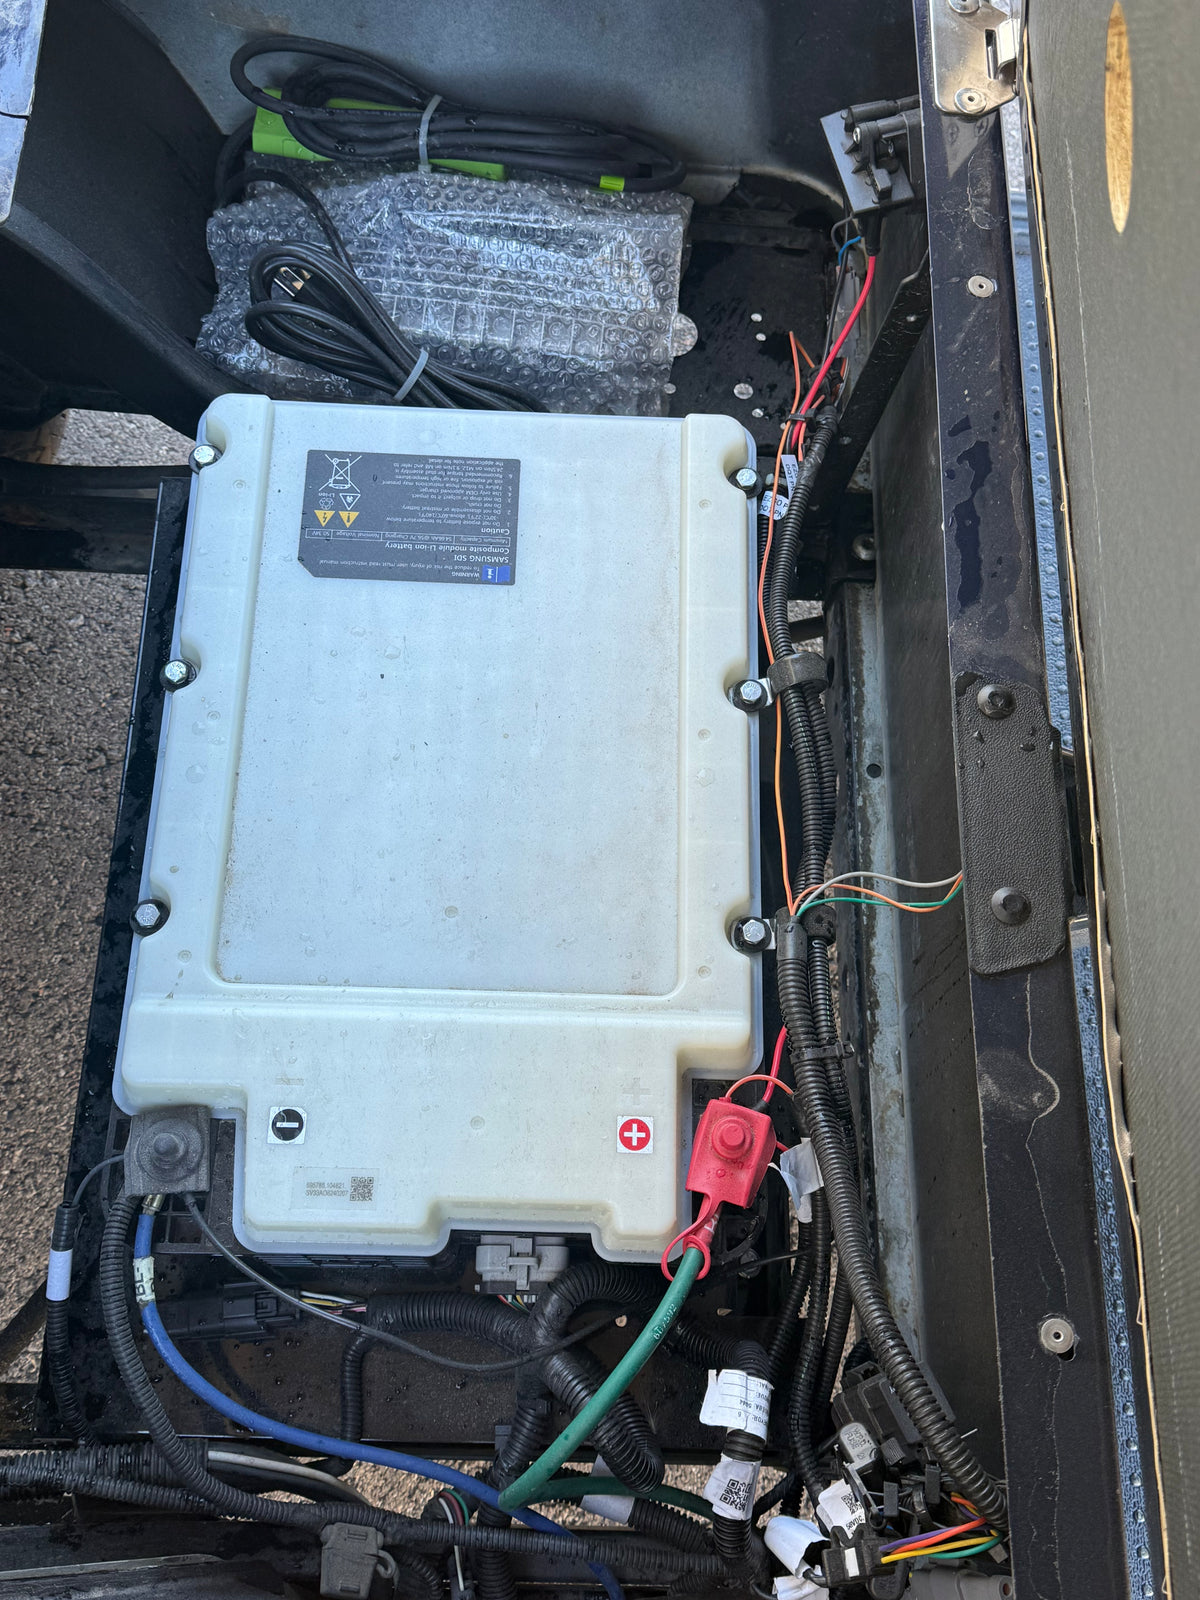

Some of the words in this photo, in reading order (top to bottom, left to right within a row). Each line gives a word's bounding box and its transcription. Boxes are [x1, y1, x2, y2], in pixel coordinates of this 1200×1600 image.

[385, 541, 412, 550] battery
[469, 545, 509, 554] Composite
[469, 555, 509, 563] SAMSUNG
